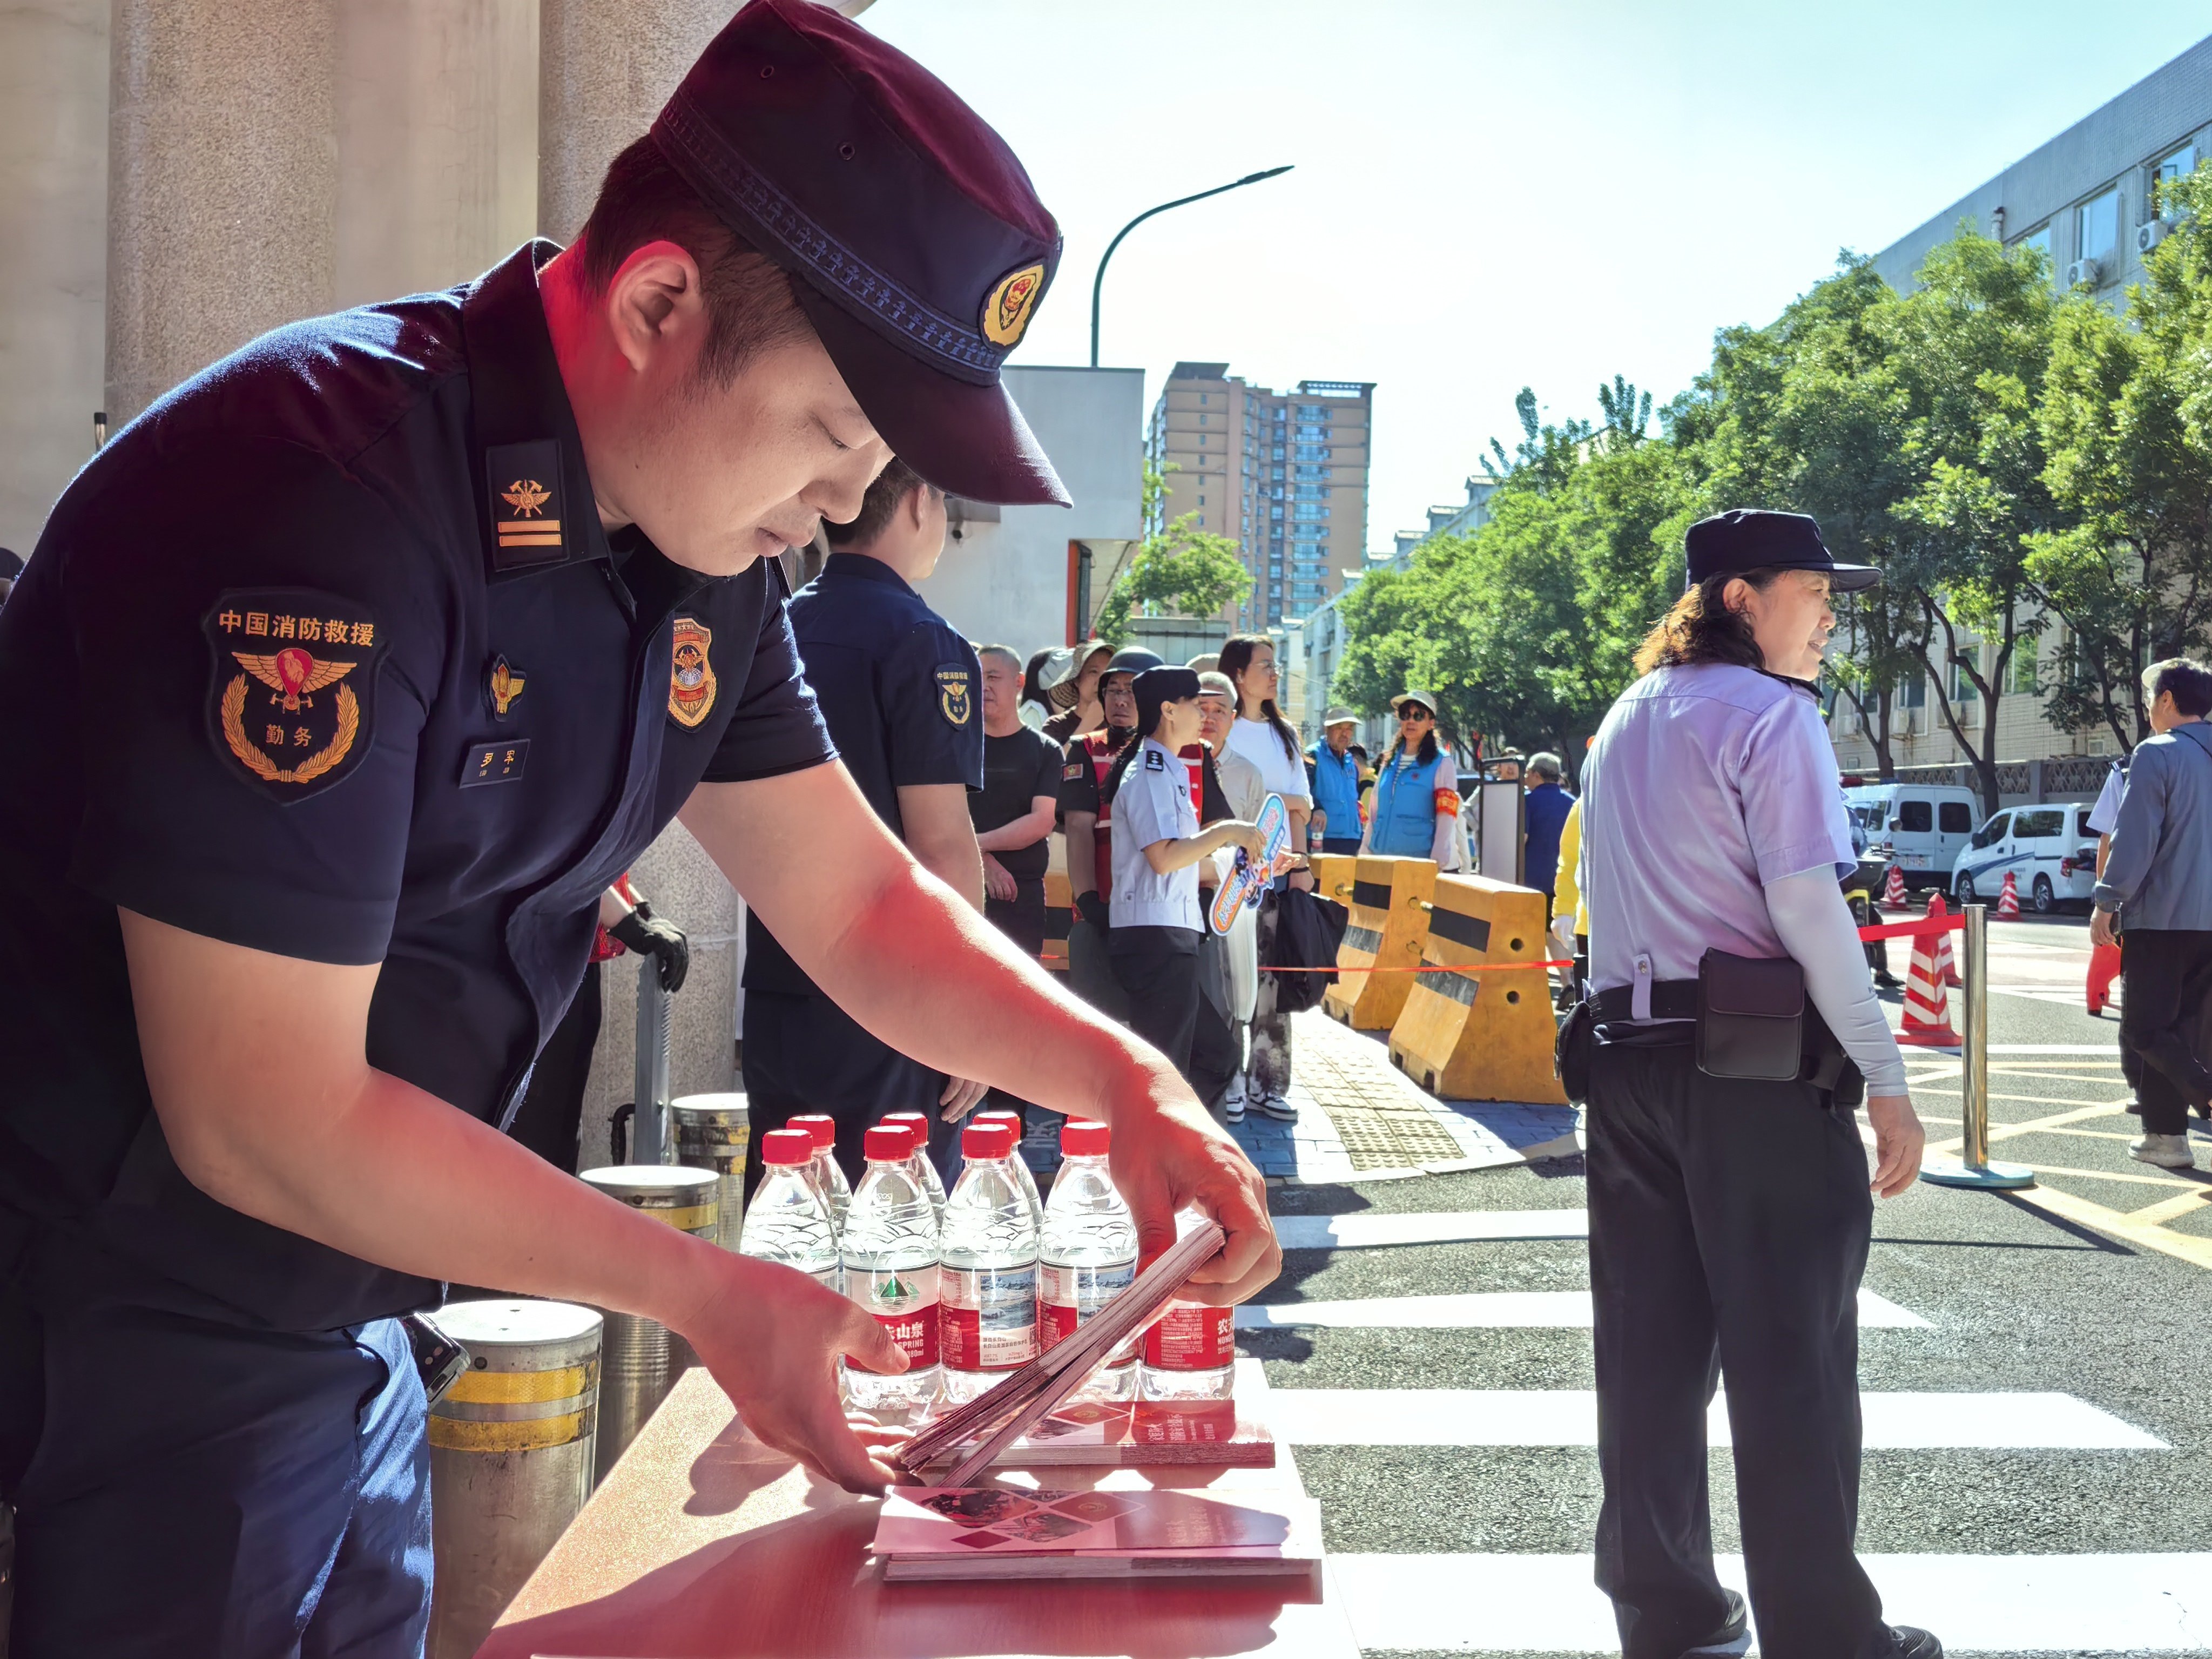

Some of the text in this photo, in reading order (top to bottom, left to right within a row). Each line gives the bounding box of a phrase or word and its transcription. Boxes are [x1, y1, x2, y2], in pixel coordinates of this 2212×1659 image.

[219, 609, 374, 647] 中国消防救援
[266, 724, 312, 746] 勤务
